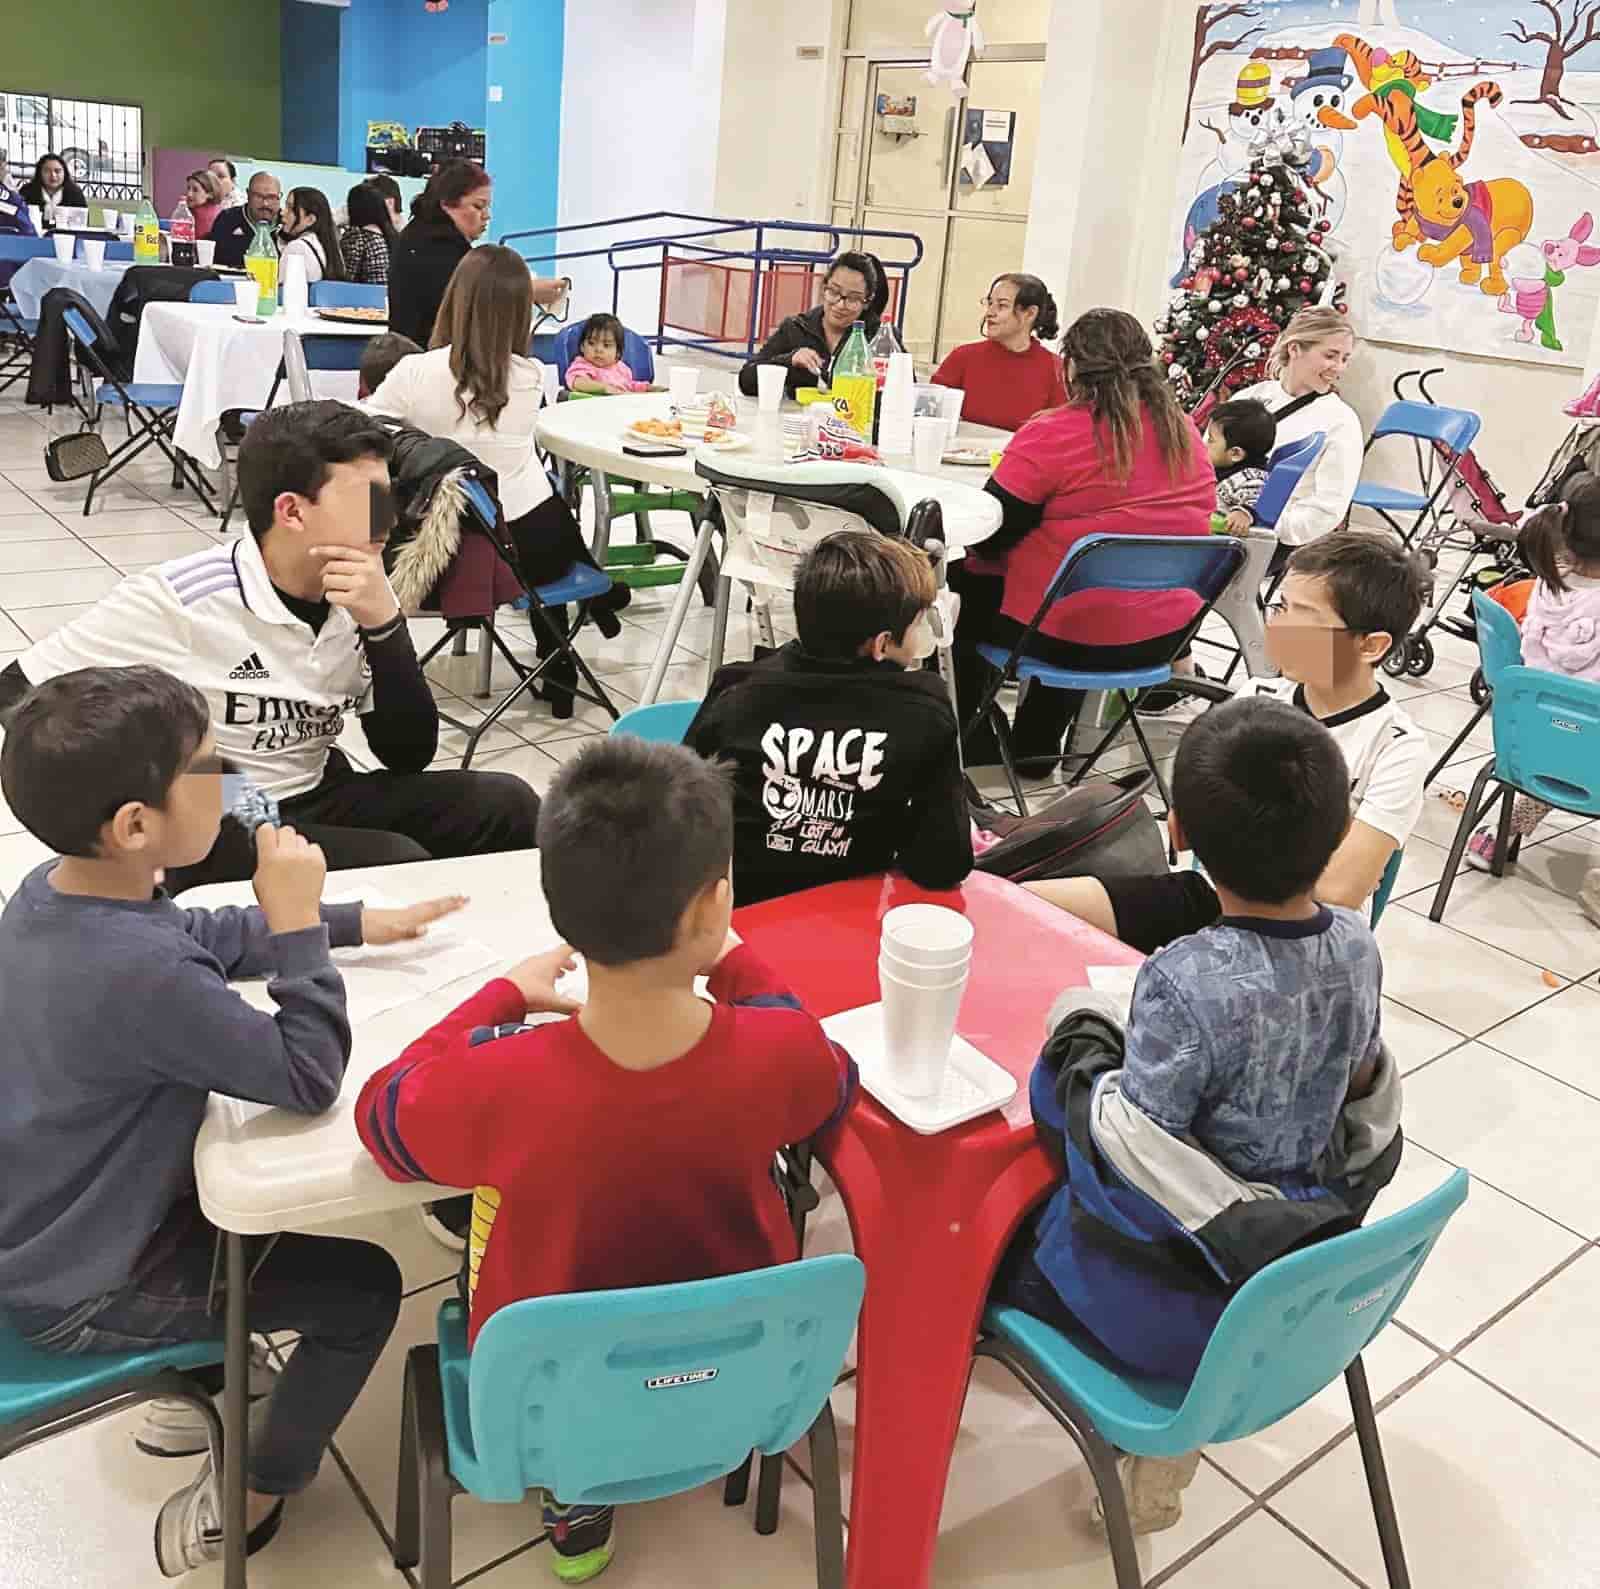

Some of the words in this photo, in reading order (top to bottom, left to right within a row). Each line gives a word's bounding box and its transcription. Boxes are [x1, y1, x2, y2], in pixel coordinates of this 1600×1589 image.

[229, 669, 270, 680] adidas
[252, 722, 290, 750] FLY
[761, 722, 888, 792] SPACE
[799, 824, 832, 840] LOST
[653, 1370, 711, 1386] LIFETIME
